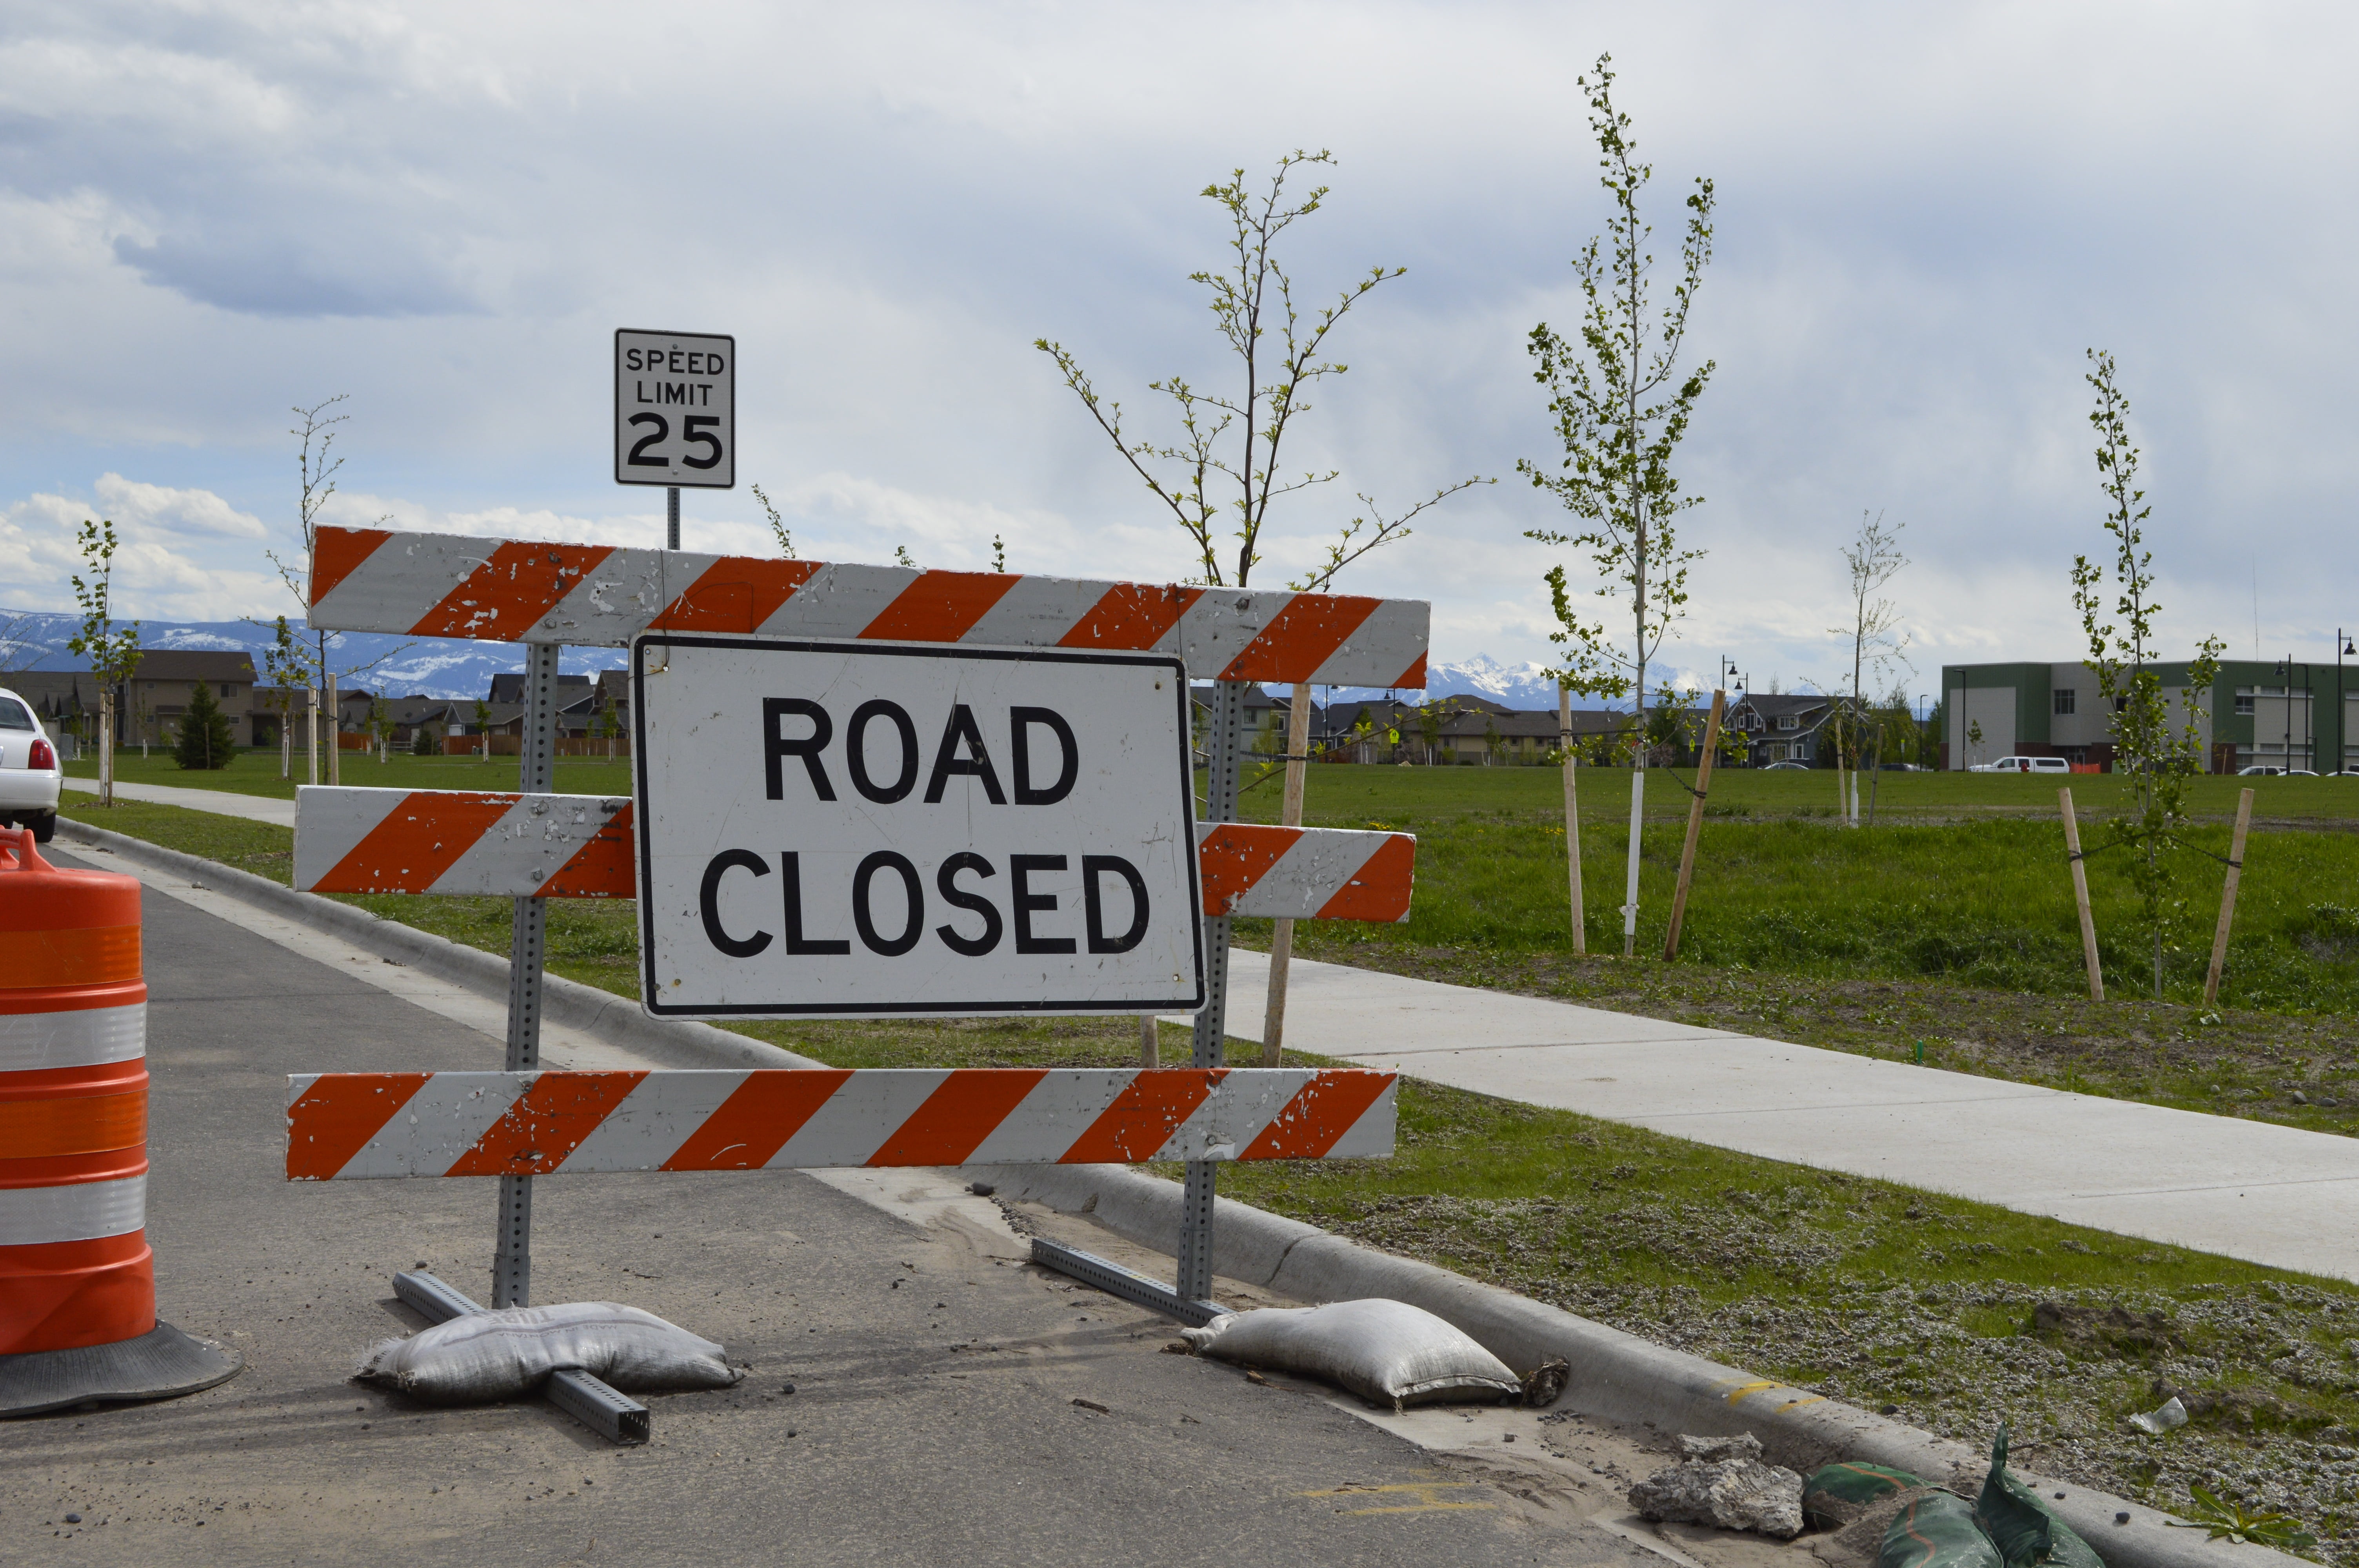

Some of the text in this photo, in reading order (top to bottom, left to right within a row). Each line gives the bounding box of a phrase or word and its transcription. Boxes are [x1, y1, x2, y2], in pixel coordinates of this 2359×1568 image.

[626, 348, 724, 375] SPEED
[637, 381, 712, 406] LIMIT
[628, 412, 723, 469] 25
[762, 697, 1079, 806] ROAD
[700, 848, 1150, 958] CLOSED
[498, 1330, 561, 1339] MONTANA
